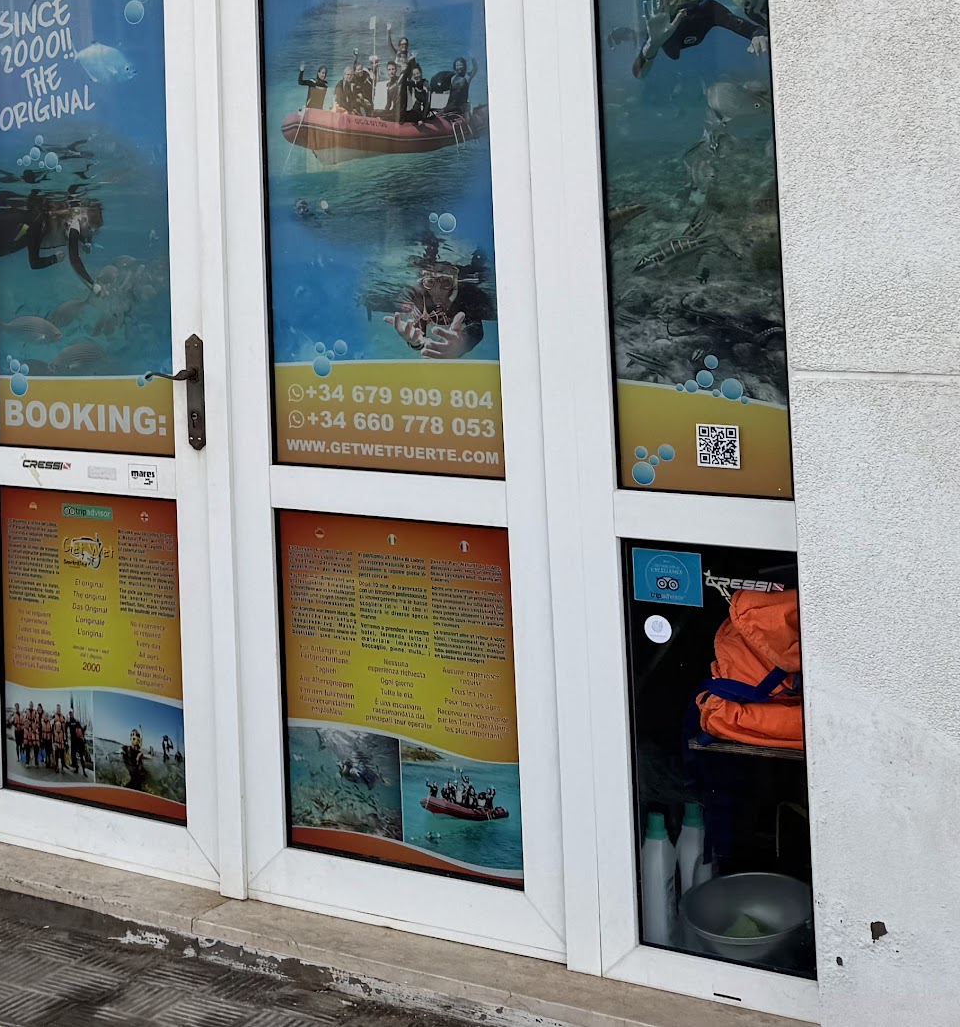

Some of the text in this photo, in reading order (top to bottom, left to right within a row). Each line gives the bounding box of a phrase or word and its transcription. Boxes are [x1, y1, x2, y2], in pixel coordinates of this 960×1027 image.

[0, 27, 74, 74] 2000!!
[21, 63, 62, 99] THE
[0, 84, 96, 131] ORIGINAL
[306, 383, 493, 409] +34 679 909 804
[4, 399, 167, 436] BOOKING:
[307, 410, 496, 438] +34 660 778 053
[287, 438, 499, 464] WWW.GETWETFUERTE.COM
[22, 459, 63, 471] CRESSI
[131, 470, 155, 479] mares
[75, 507, 111, 518] tripadvisor
[705, 576, 772, 592] CRESSI
[73, 590, 107, 601] The original
[72, 602, 108, 614] Das Original
[82, 661, 101, 673] 2000
